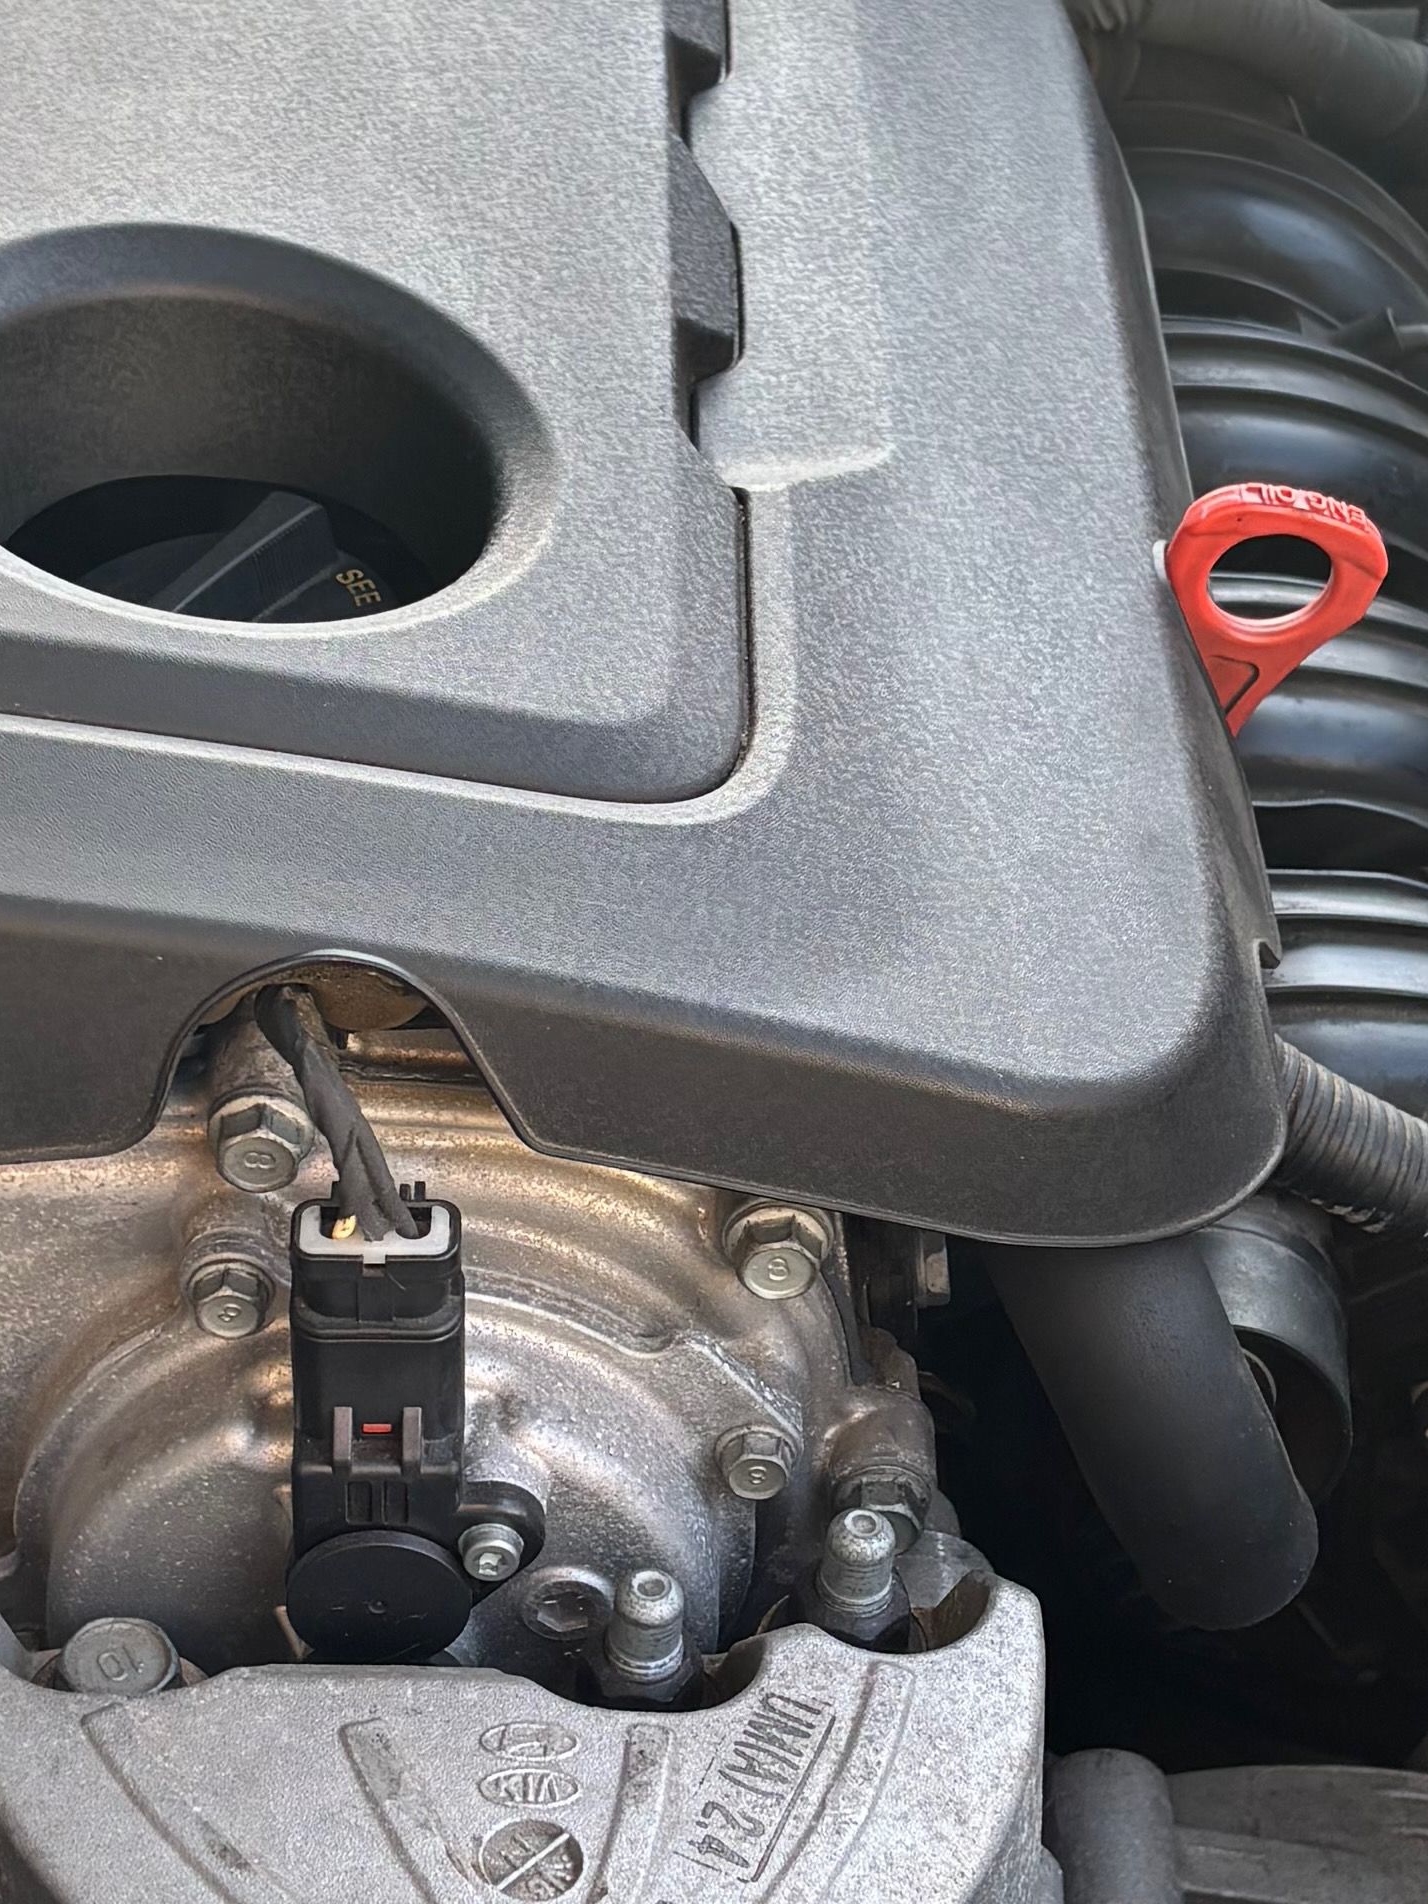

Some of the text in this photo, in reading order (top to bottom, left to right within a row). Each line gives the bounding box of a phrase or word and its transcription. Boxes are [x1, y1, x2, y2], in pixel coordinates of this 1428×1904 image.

[335, 568, 382, 608] SEE
[97, 1645, 145, 1682] 10
[718, 1693, 822, 1799] UM(A)
[493, 1772, 561, 1804] KIA
